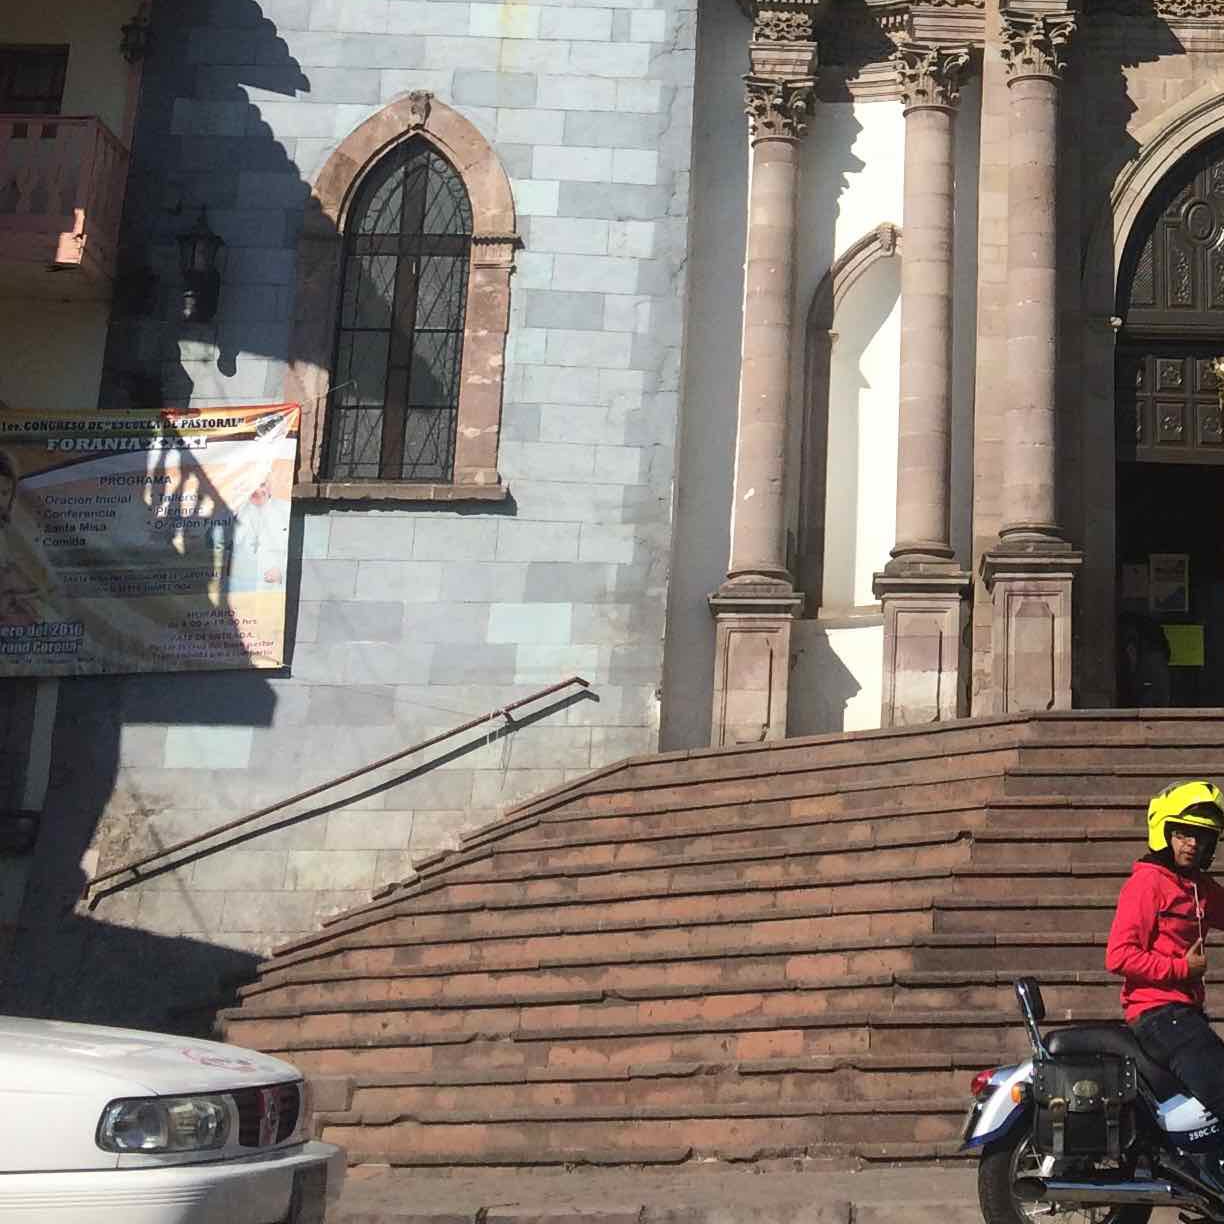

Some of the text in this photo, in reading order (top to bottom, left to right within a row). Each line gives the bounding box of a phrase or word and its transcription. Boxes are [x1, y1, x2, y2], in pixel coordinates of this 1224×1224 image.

[24, 420, 85, 432] CONGRESO
[47, 437, 140, 451] FORANIA
[99, 475, 172, 486] PROGRAMA
